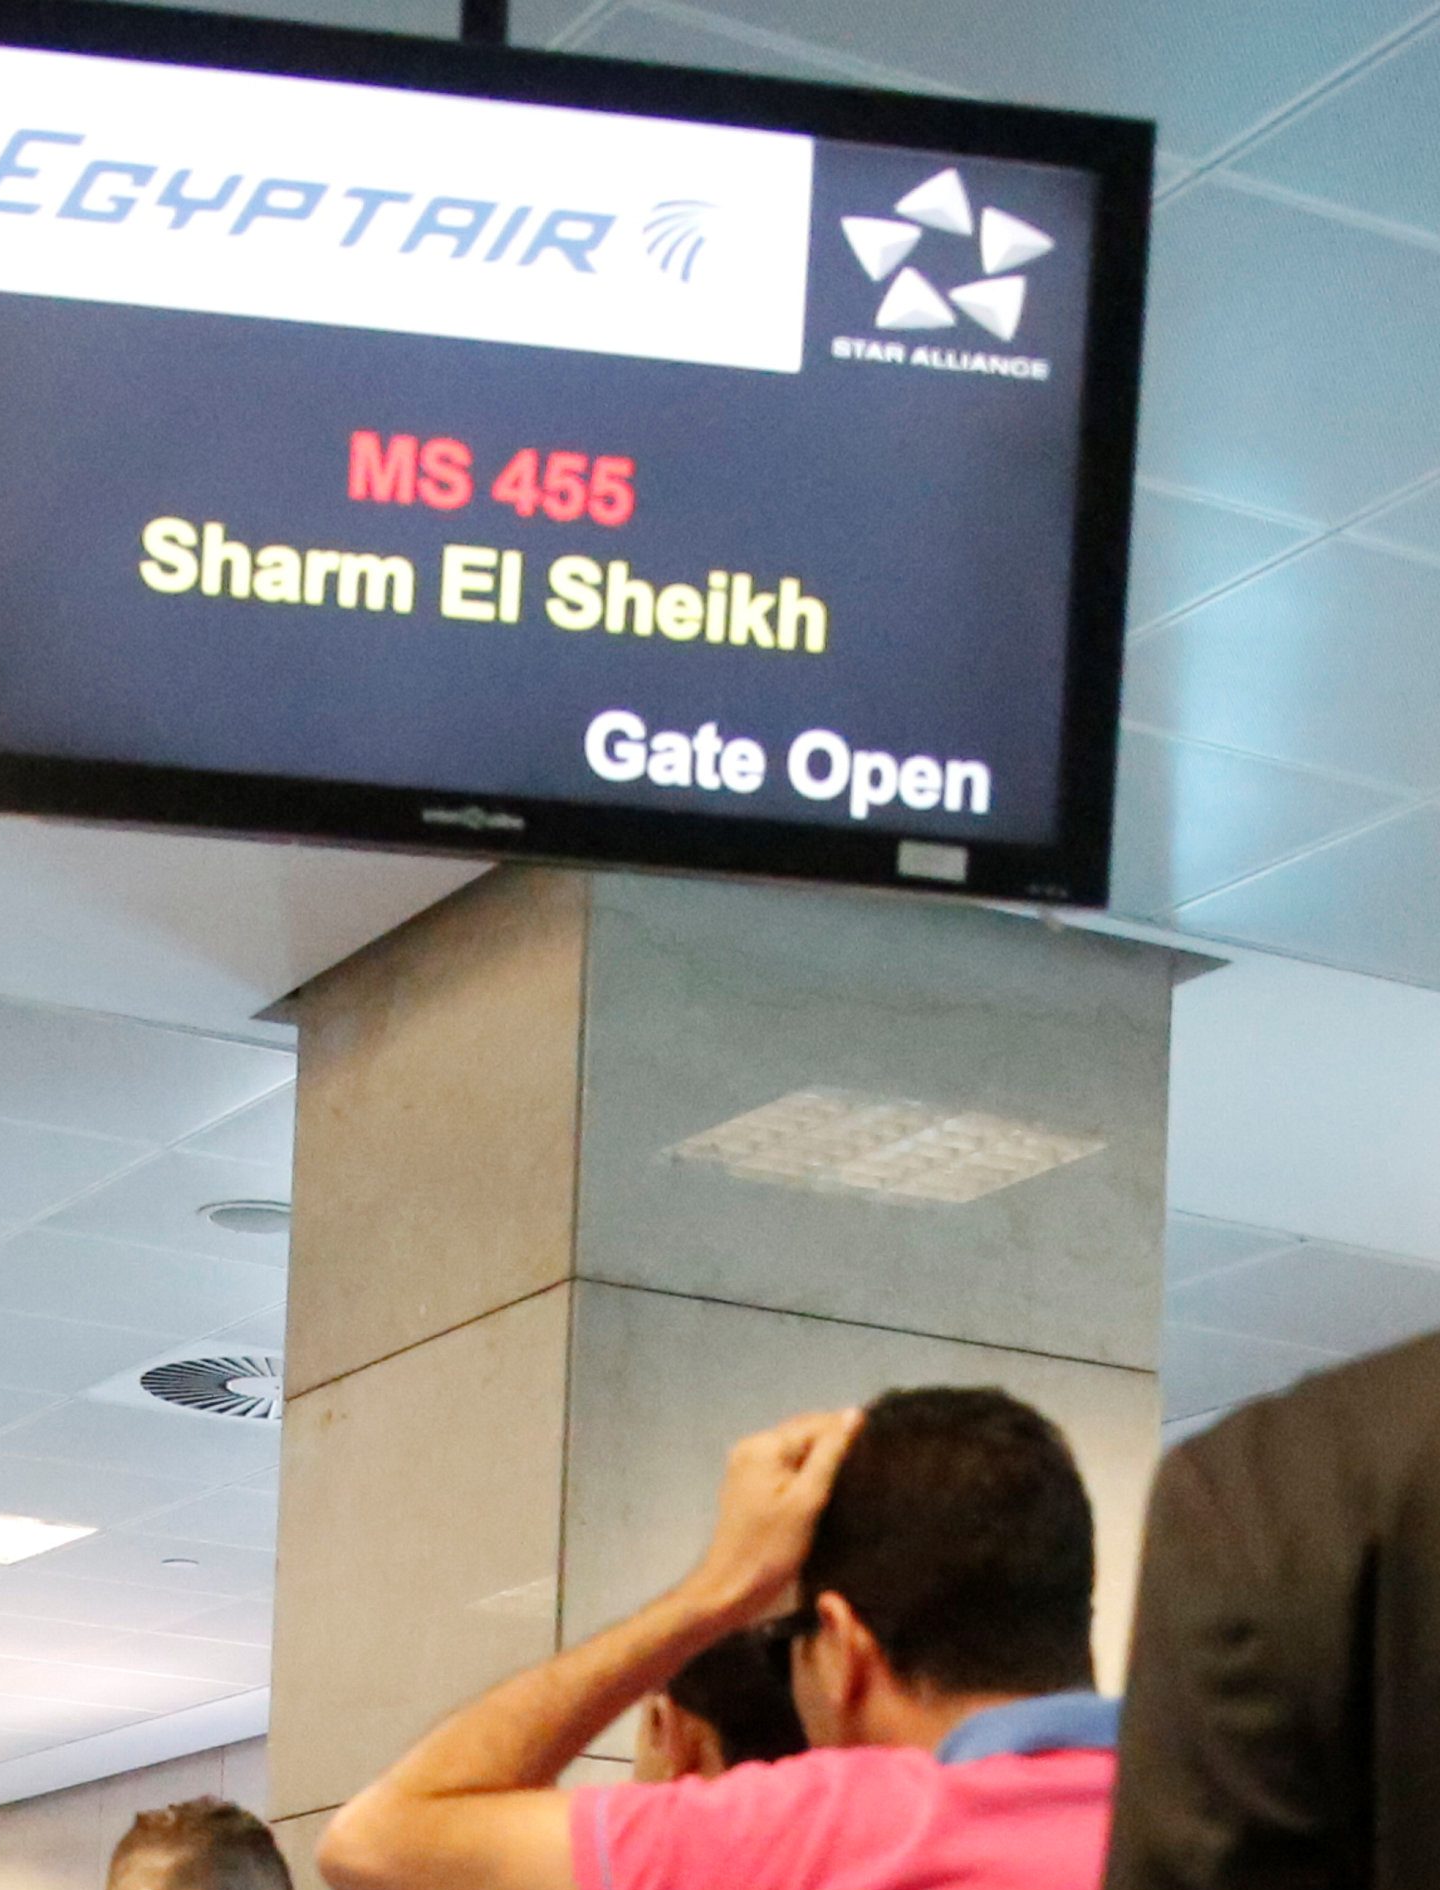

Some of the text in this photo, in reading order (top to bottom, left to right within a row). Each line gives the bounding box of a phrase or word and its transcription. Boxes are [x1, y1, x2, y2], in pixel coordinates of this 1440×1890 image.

[831, 336, 1053, 381] STAR ALLIANCE
[346, 430, 637, 528] MS 455
[140, 516, 829, 653] Sharm El Sheikh
[585, 709, 992, 820] Gate Open
